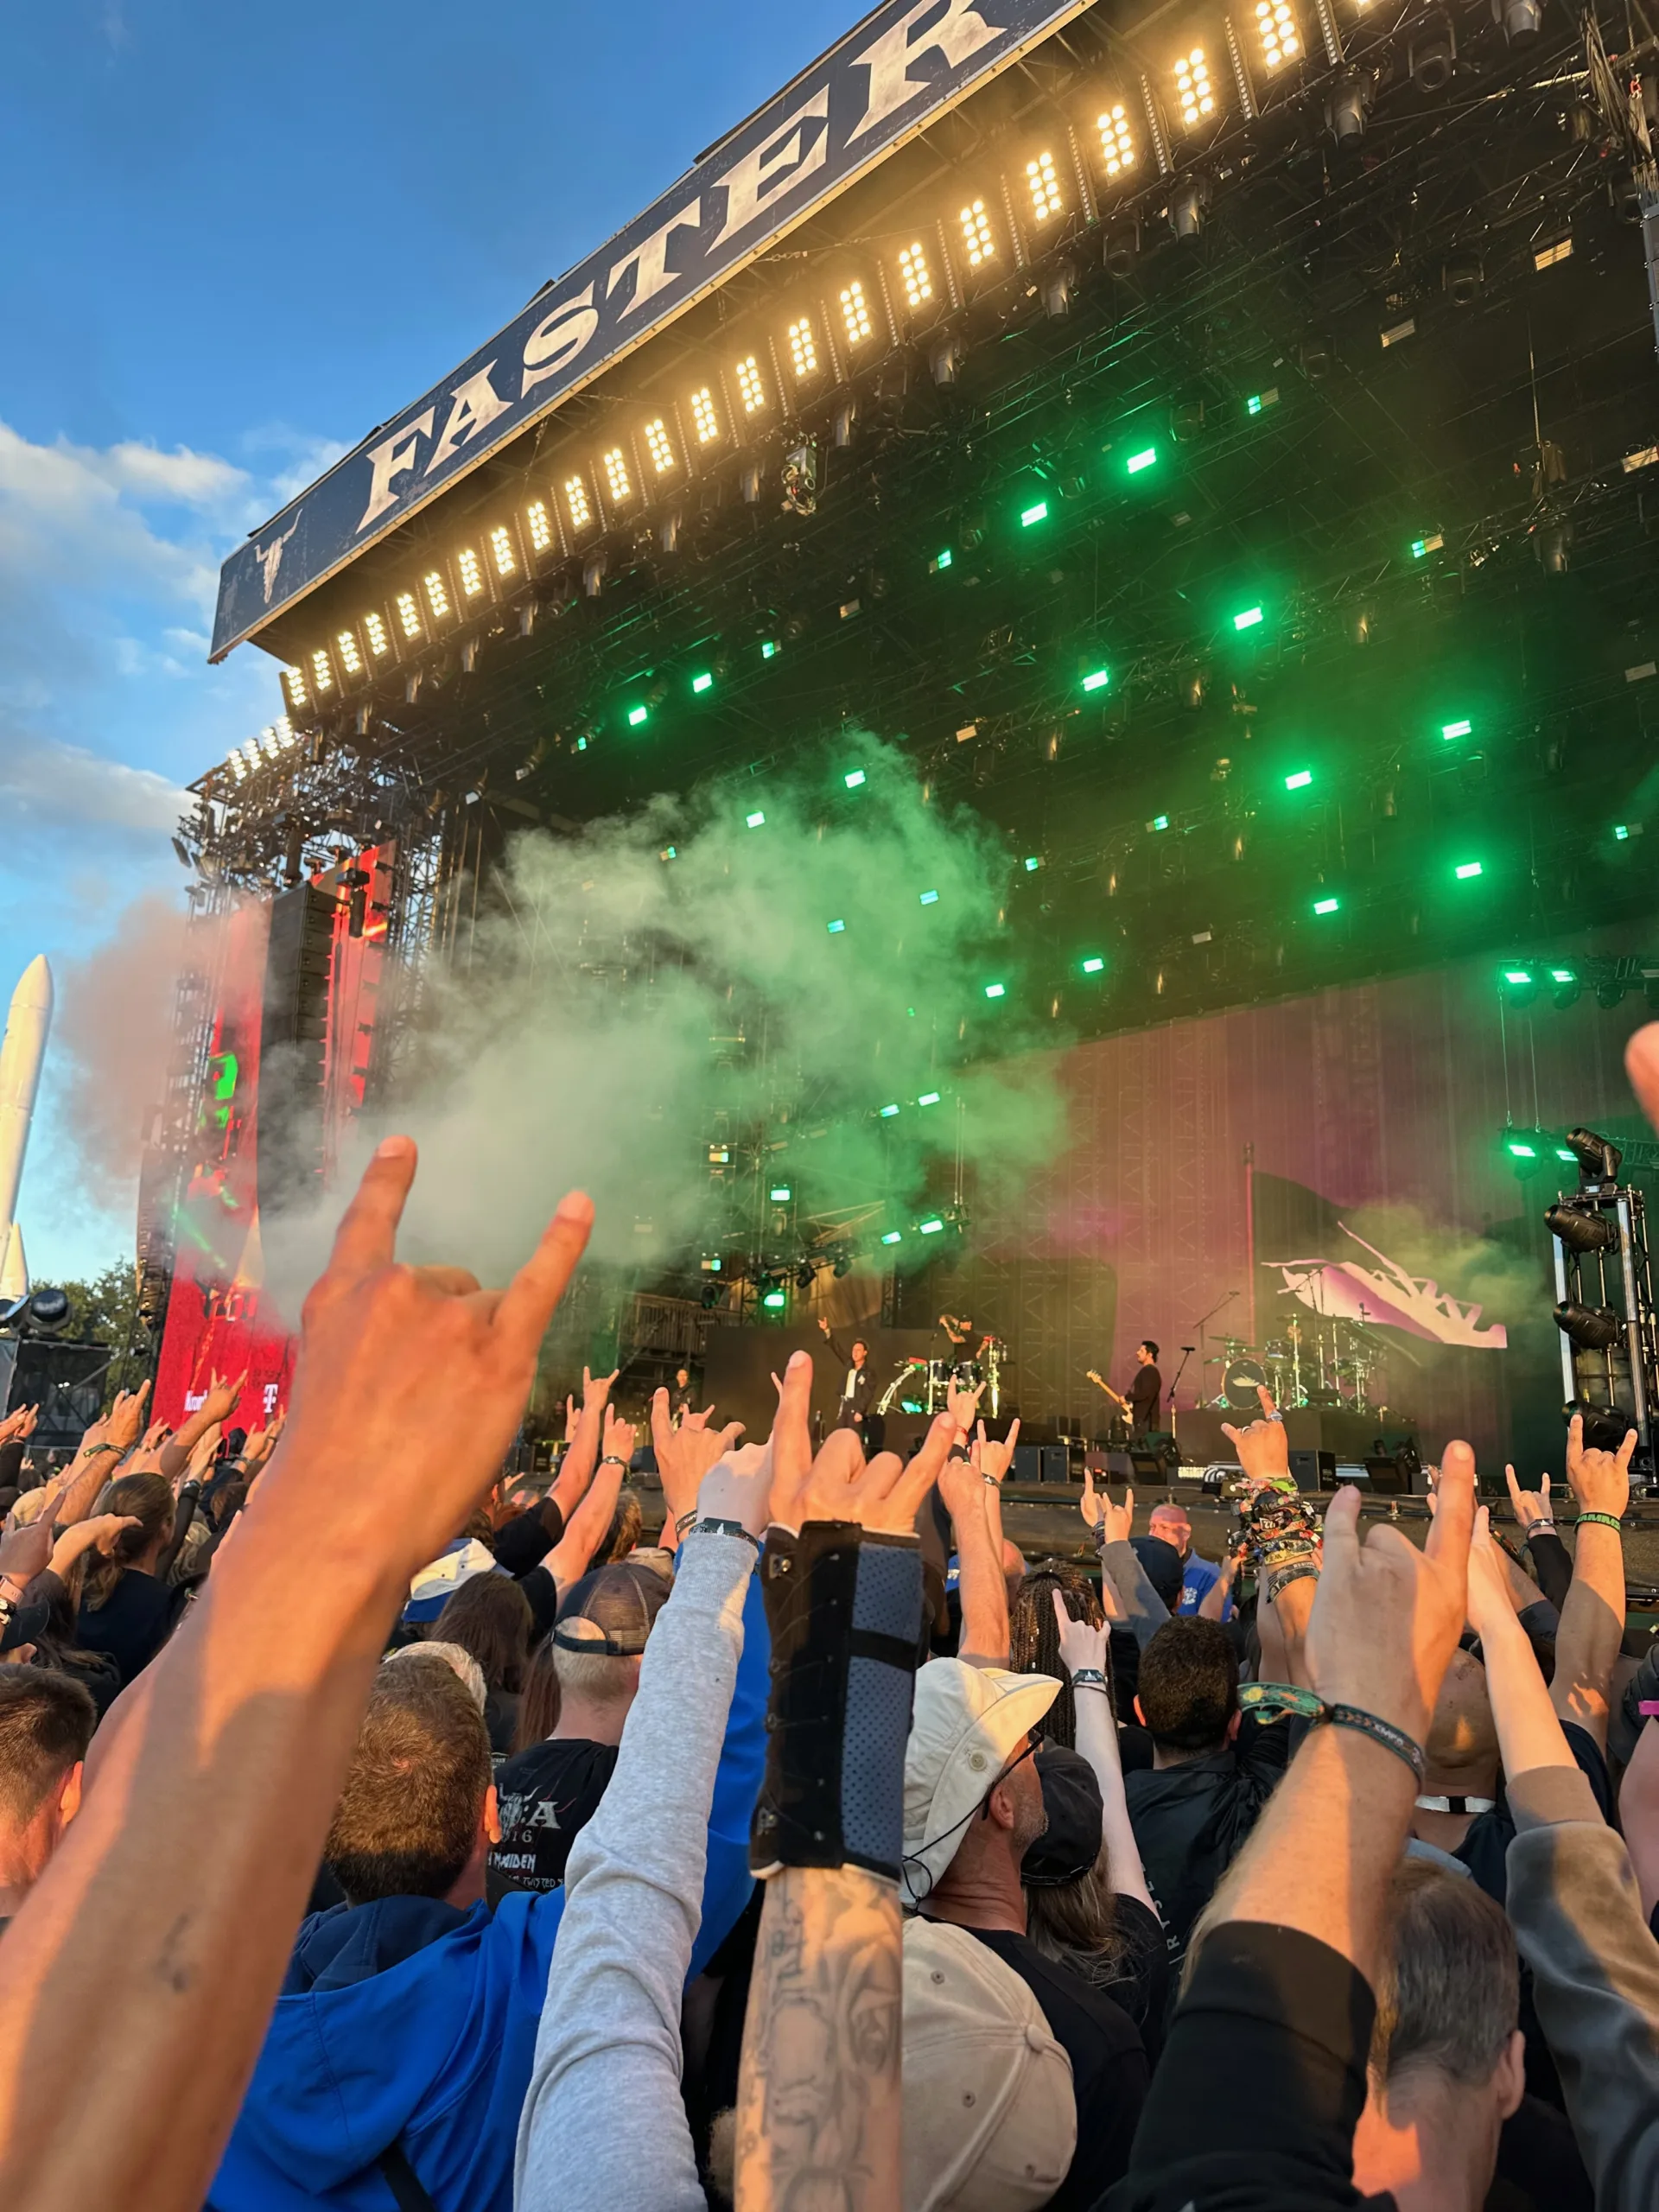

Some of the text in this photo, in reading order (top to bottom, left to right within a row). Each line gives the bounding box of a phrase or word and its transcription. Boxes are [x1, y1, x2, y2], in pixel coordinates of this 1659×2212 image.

[355, 0, 1008, 535] FASTER
[493, 1853, 537, 1873] MAIDEN
[523, 1877, 556, 1890] TWISTED
